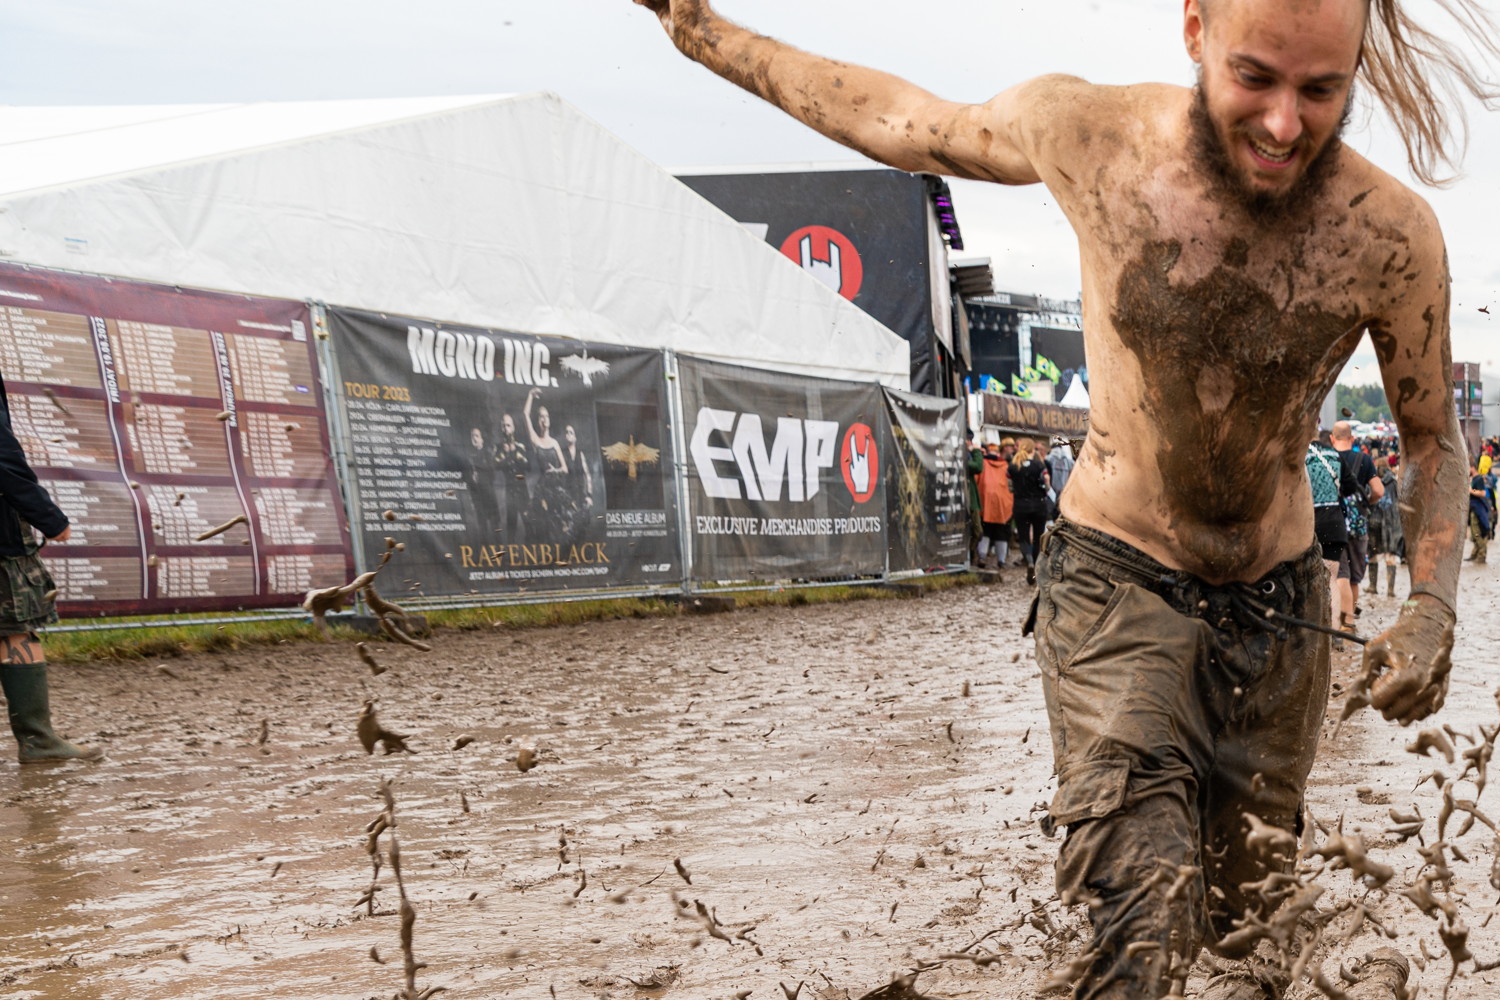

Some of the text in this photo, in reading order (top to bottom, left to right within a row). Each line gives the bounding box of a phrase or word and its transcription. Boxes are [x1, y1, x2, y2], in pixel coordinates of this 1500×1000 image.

[407, 325, 559, 388] MONO INC.
[107, 367, 120, 403] FRIDAY
[344, 381, 412, 402] TOUR 2023
[1007, 403, 1089, 431] BAND MERCHA
[689, 406, 840, 502] EMP
[605, 512, 666, 524] DAS NEUE ALBUM
[696, 515, 759, 535] EXCLUSIVE
[759, 517, 834, 536] MERCHANDISE
[460, 542, 611, 568] RAVENBLACK
[484, 570, 504, 580] ALBUM
[509, 569, 531, 579] TICKETS
